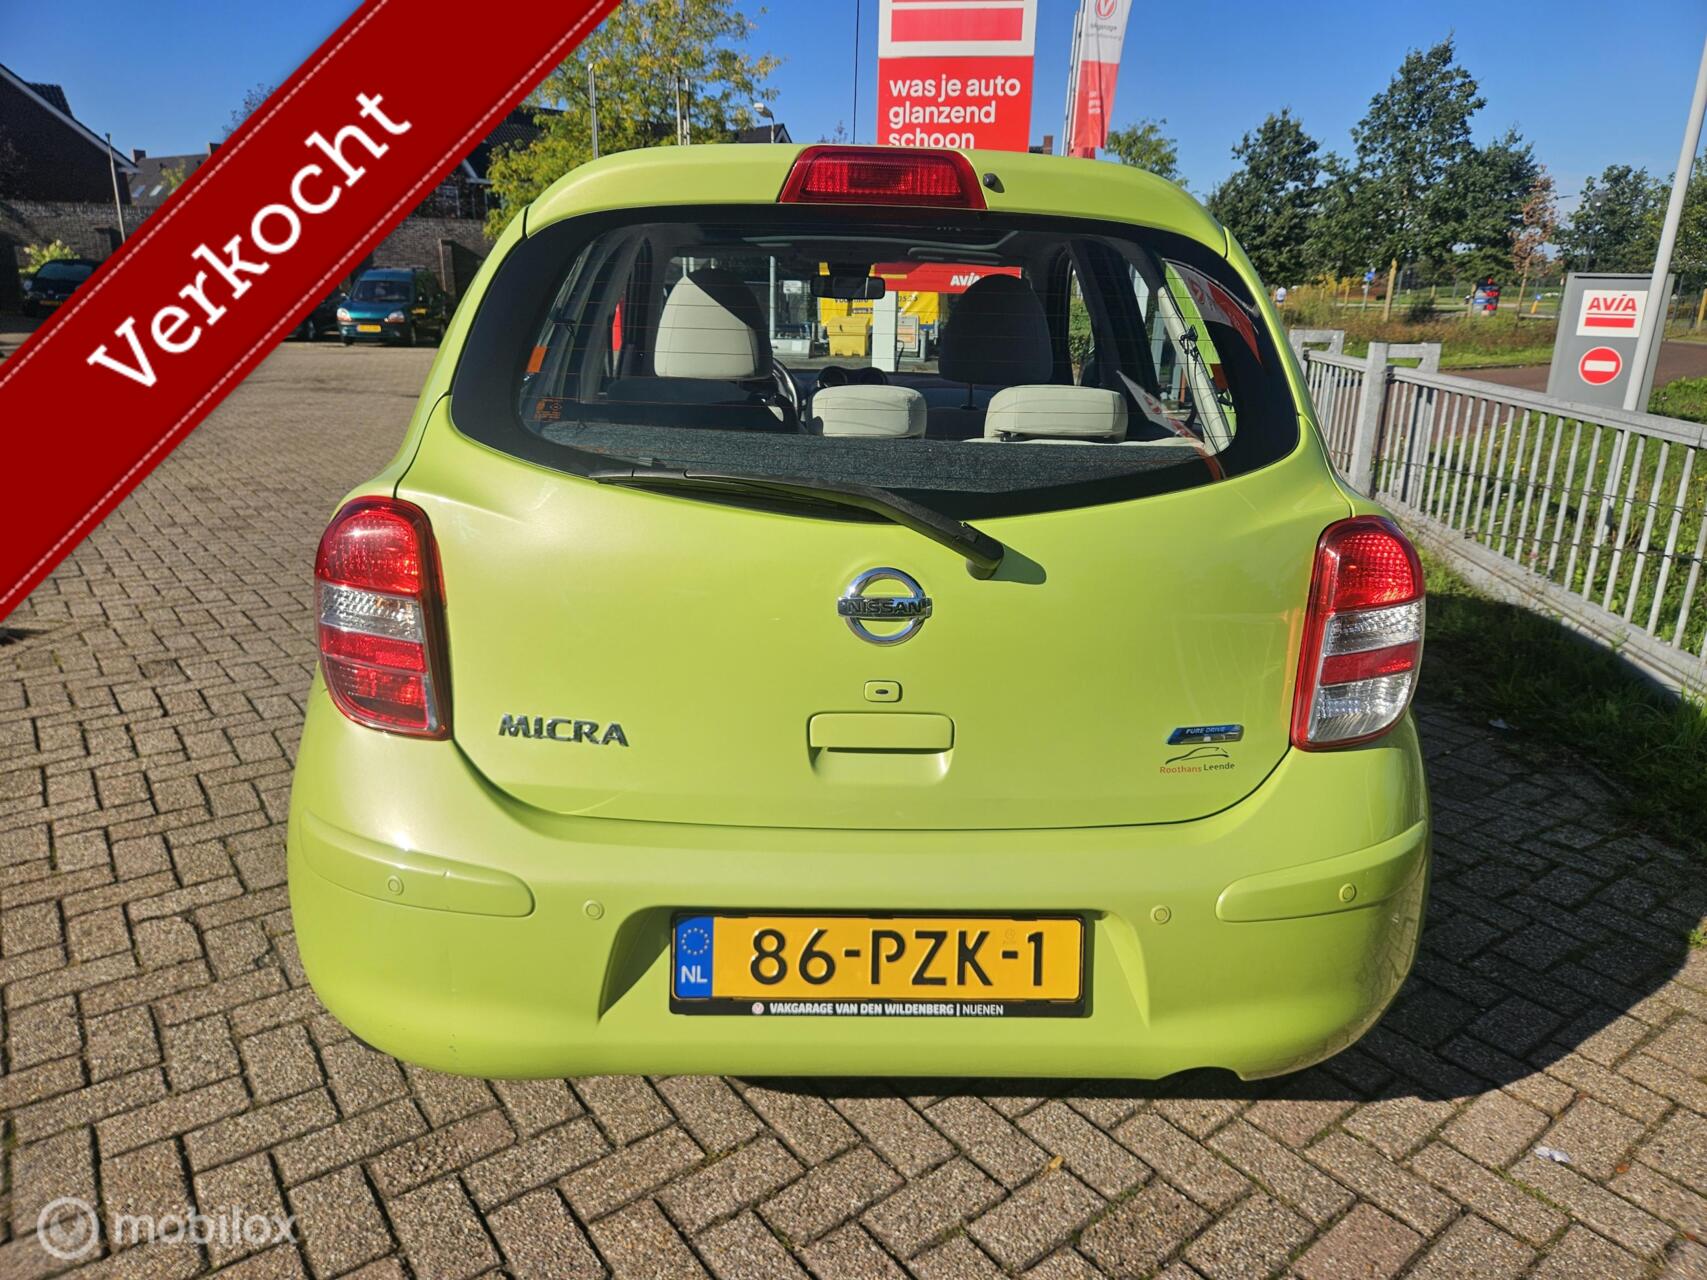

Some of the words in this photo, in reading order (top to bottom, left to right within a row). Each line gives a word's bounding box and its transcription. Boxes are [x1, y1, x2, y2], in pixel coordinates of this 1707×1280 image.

[888, 79, 937, 97] was
[937, 73, 962, 103] je
[966, 74, 1021, 97] auto
[888, 100, 997, 130] glanzend
[888, 127, 975, 149] schoon
[847, 600, 922, 614] NISSAN
[498, 712, 630, 748] MICRA
[1160, 765, 1202, 774] Roothans
[1203, 762, 1236, 771] Leende
[750, 928, 1044, 987] 86-PZK-1
[680, 965, 709, 984] NL
[769, 1002, 834, 1015] VAKGARAGE
[835, 1003, 858, 1015] VAN
[861, 1003, 882, 1015] DEN
[884, 1003, 955, 1016] WILDENBERG
[962, 1004, 1004, 1016] NUENEN
